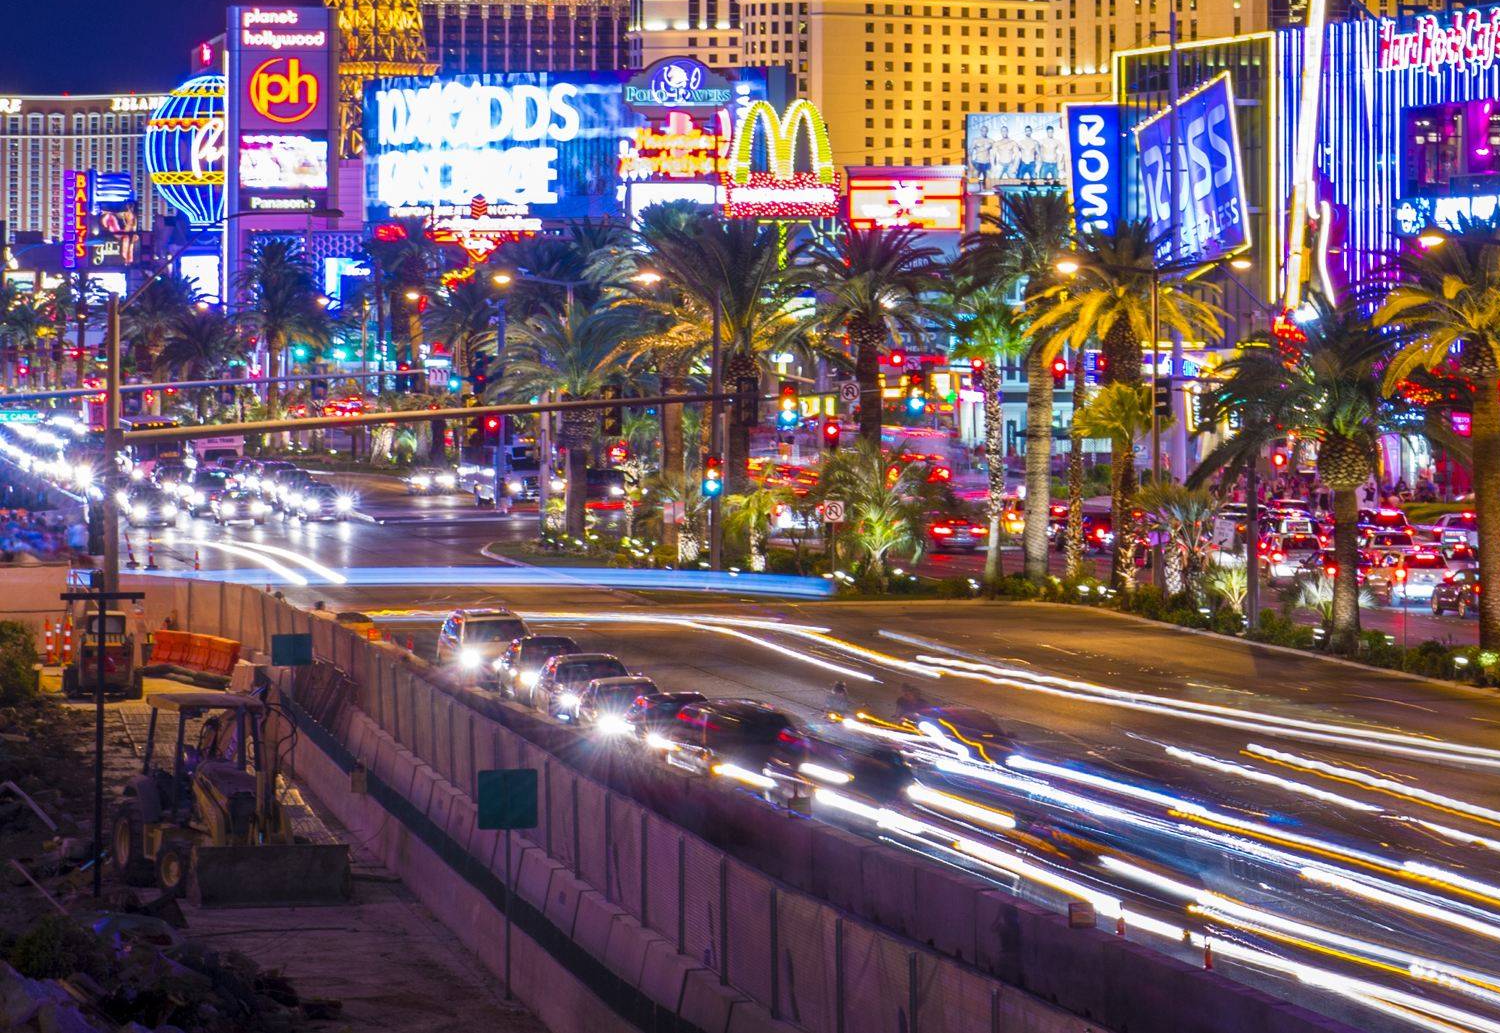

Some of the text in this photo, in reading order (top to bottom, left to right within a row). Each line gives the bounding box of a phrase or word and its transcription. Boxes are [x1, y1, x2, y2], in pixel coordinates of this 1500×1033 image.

[243, 7, 298, 26] planet
[243, 30, 325, 49] hollywood
[259, 59, 318, 112] ph
[111, 97, 164, 111] ISLAN
